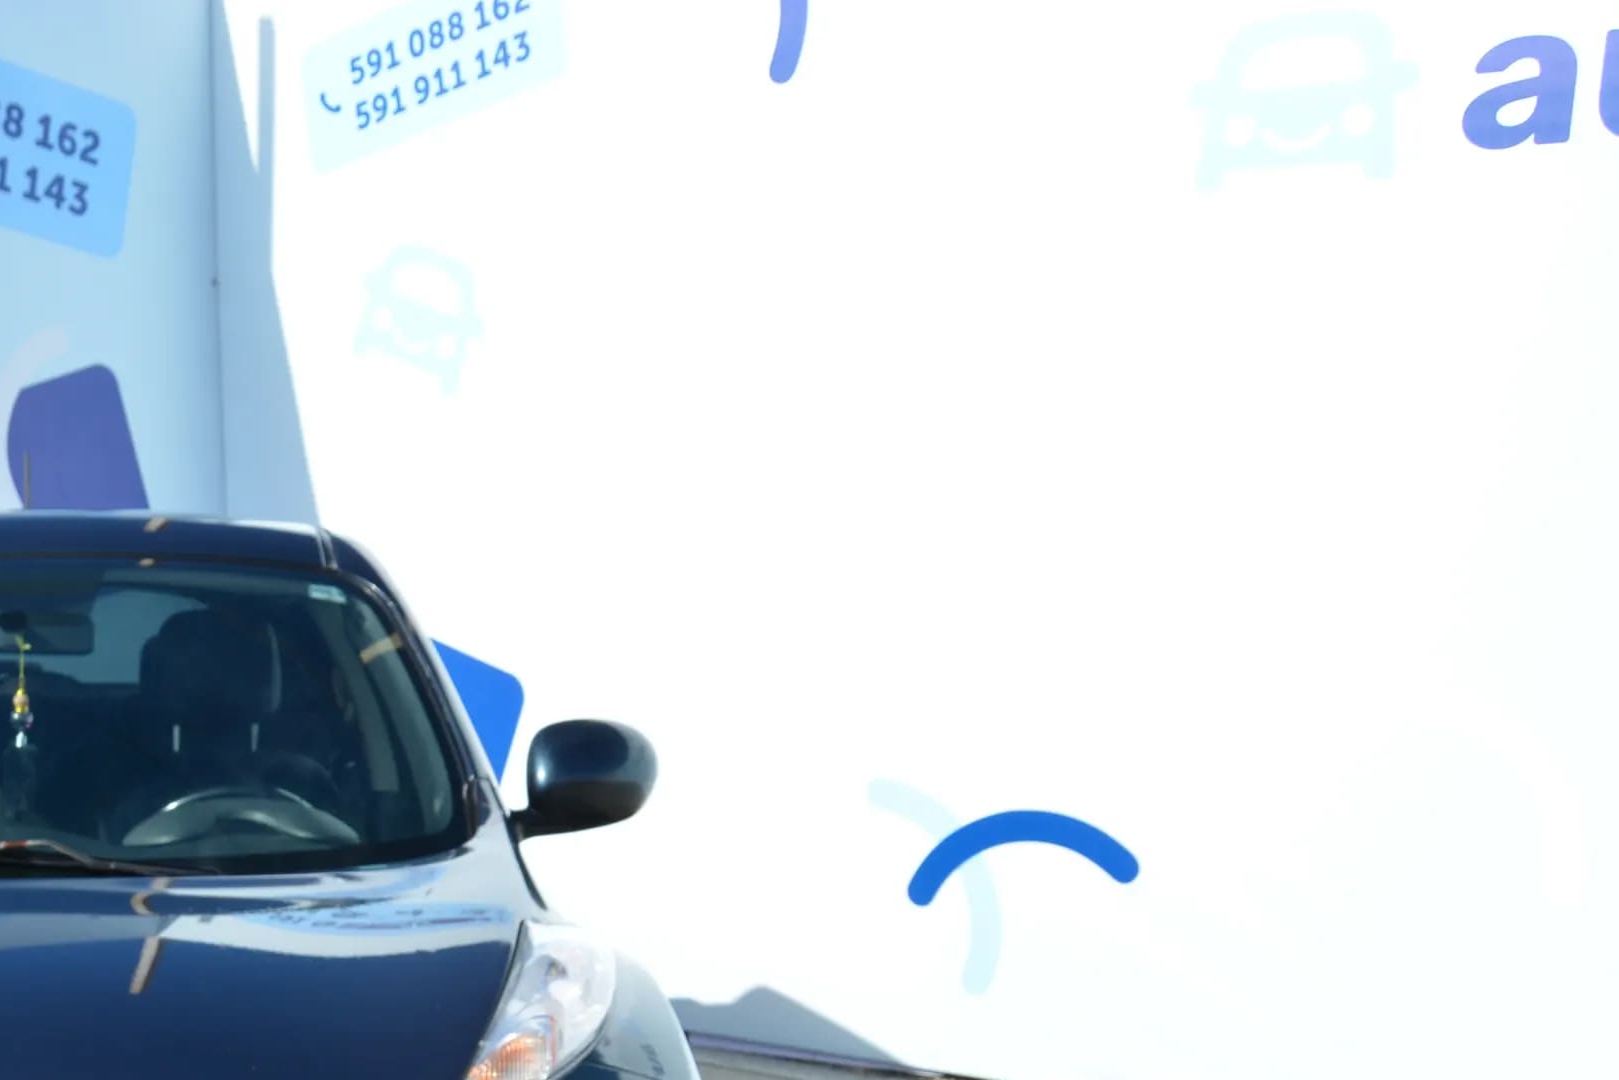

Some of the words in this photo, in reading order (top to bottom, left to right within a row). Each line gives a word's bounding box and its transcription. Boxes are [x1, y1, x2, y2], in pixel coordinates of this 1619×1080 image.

[349, 41, 400, 85] 591
[409, 12, 465, 57] 088
[355, 86, 406, 130] 591
[414, 60, 466, 104] 911
[475, 31, 531, 79] 143
[35, 114, 100, 165] 162
[23, 167, 89, 216] 143
